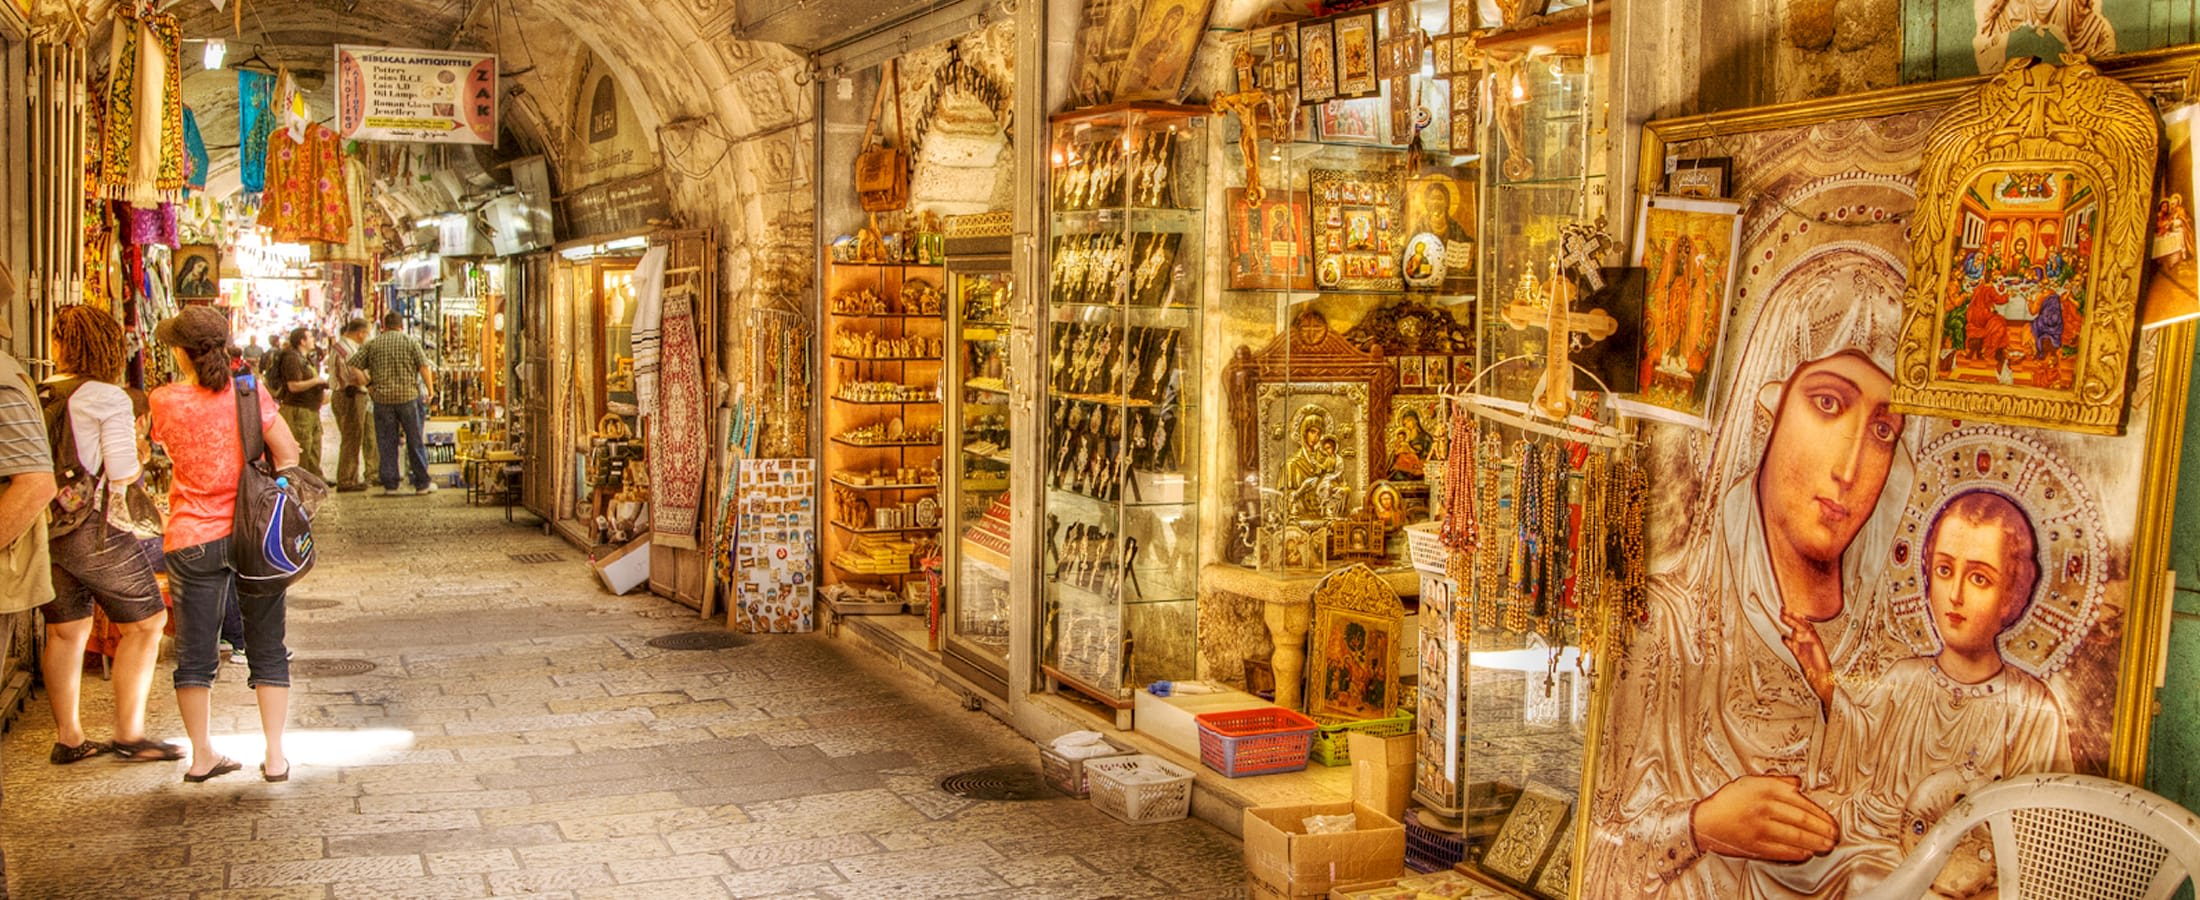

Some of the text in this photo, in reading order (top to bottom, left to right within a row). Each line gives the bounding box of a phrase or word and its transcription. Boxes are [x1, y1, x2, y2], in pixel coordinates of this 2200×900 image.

[362, 55, 473, 68] BIBLICAL ANTIQUITIES
[373, 73, 398, 82] Coins
[373, 81, 393, 89] Coin
[389, 90, 418, 100] Lamps
[475, 69, 491, 117] ZAK
[373, 99, 405, 108] Roman
[374, 107, 416, 118] Jewellery
